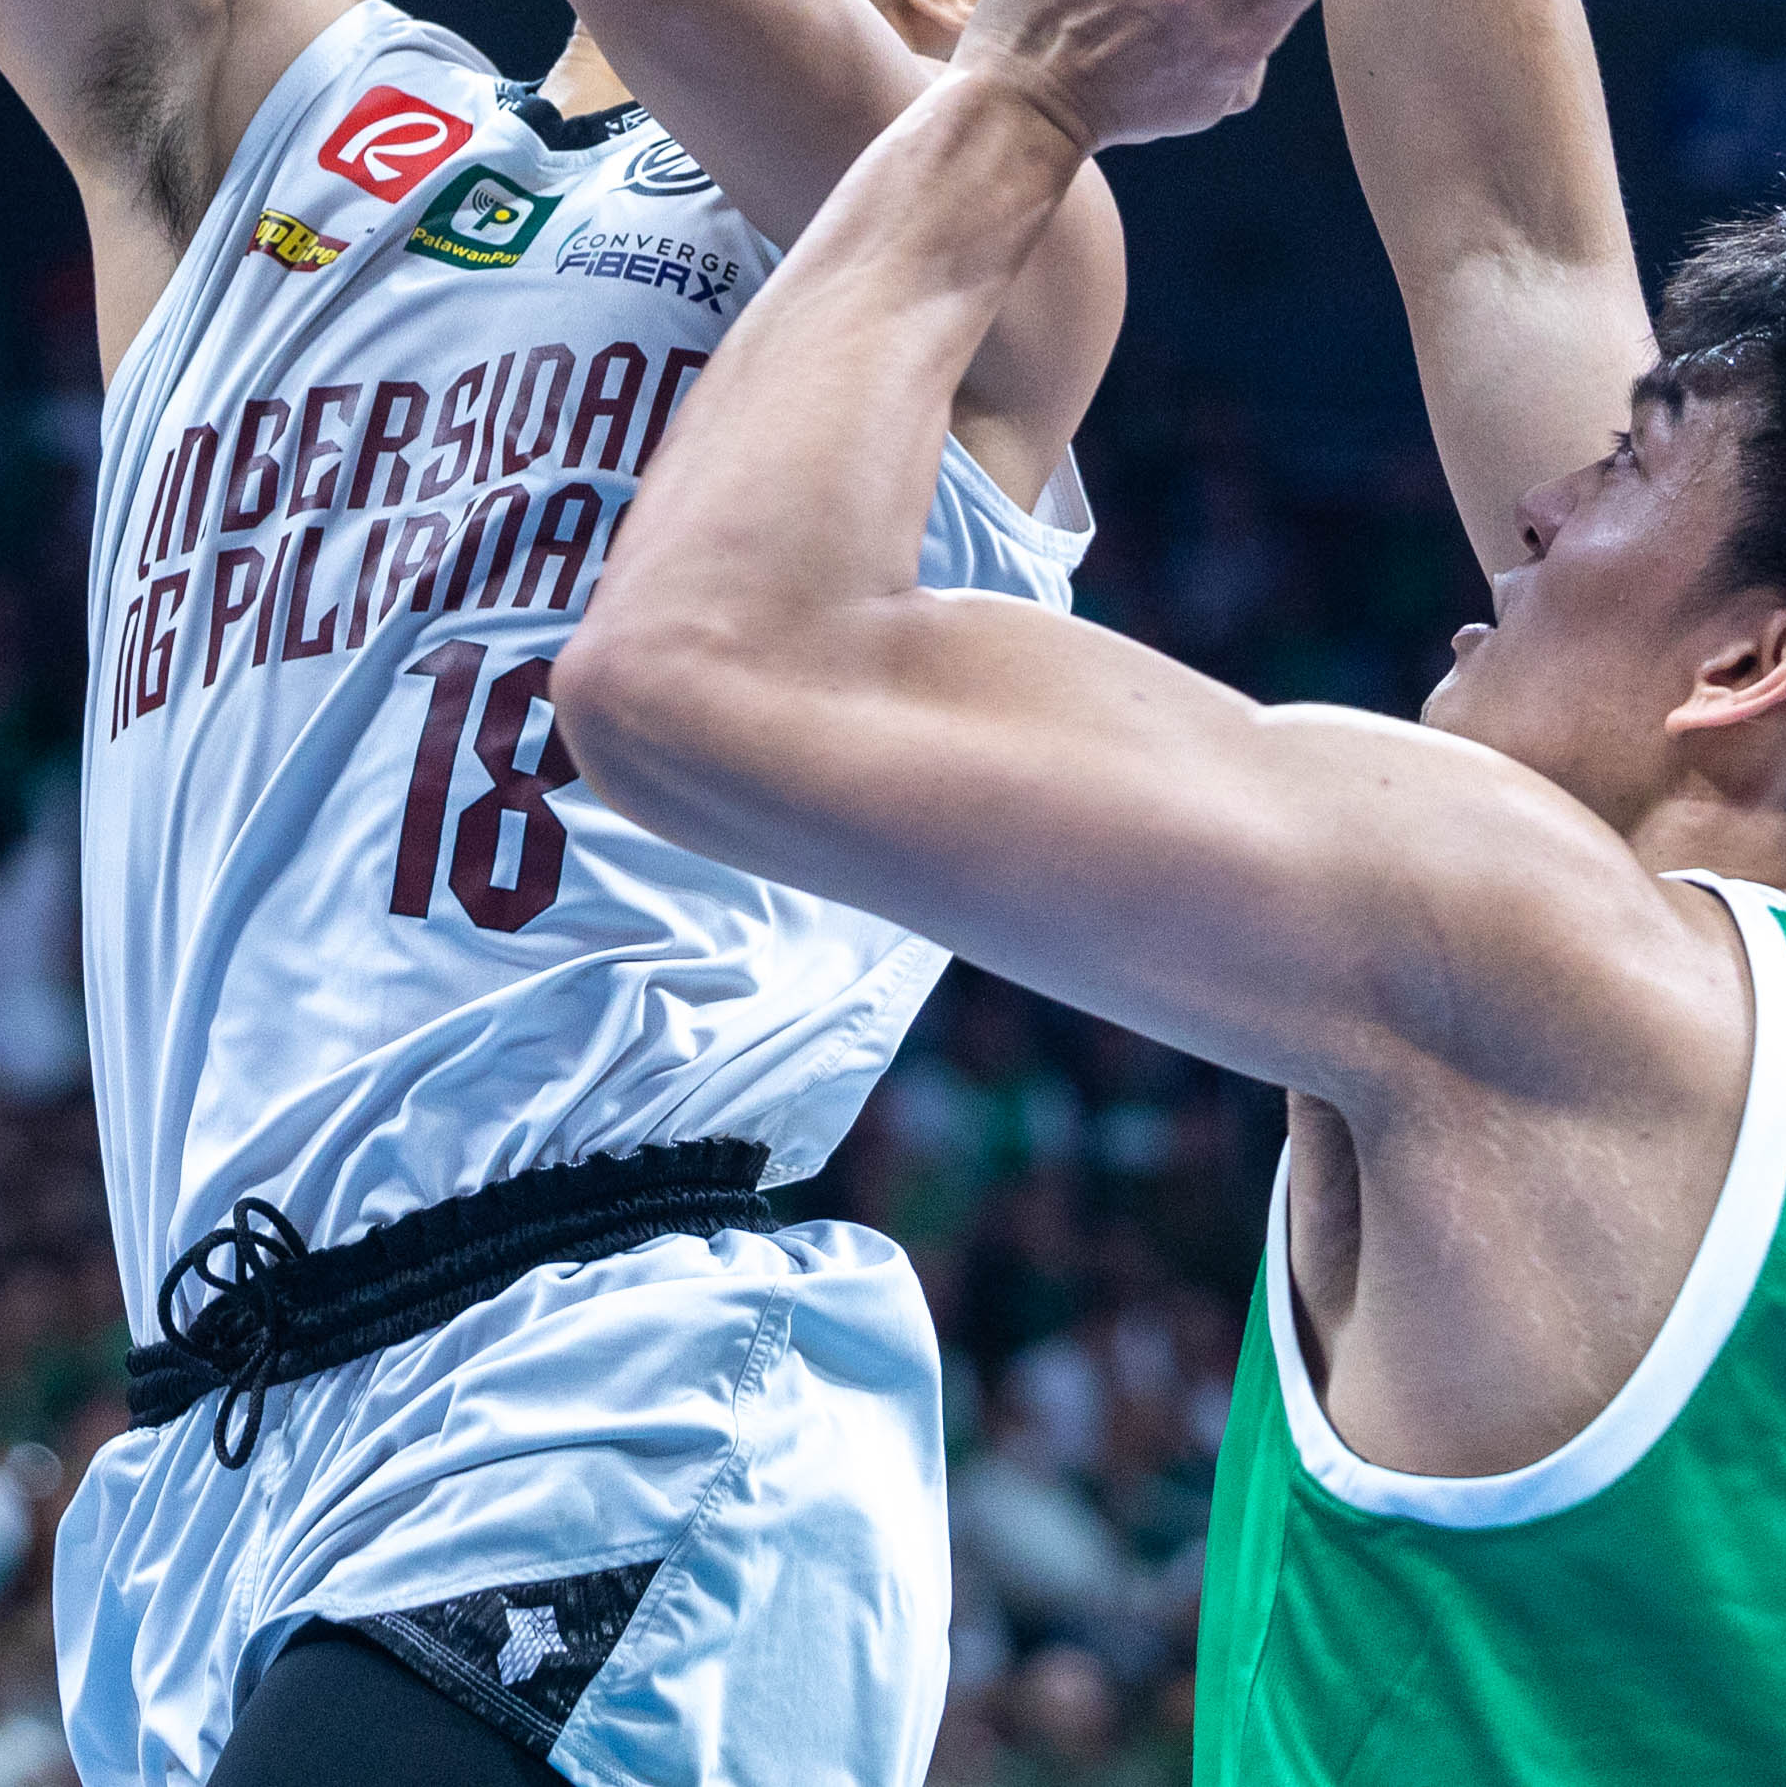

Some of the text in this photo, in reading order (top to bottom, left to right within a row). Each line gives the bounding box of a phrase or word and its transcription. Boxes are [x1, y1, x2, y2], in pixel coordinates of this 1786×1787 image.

[412, 227, 521, 265] PalawanPay
[572, 232, 739, 284] CONVERGE
[389, 639, 580, 933] 18
